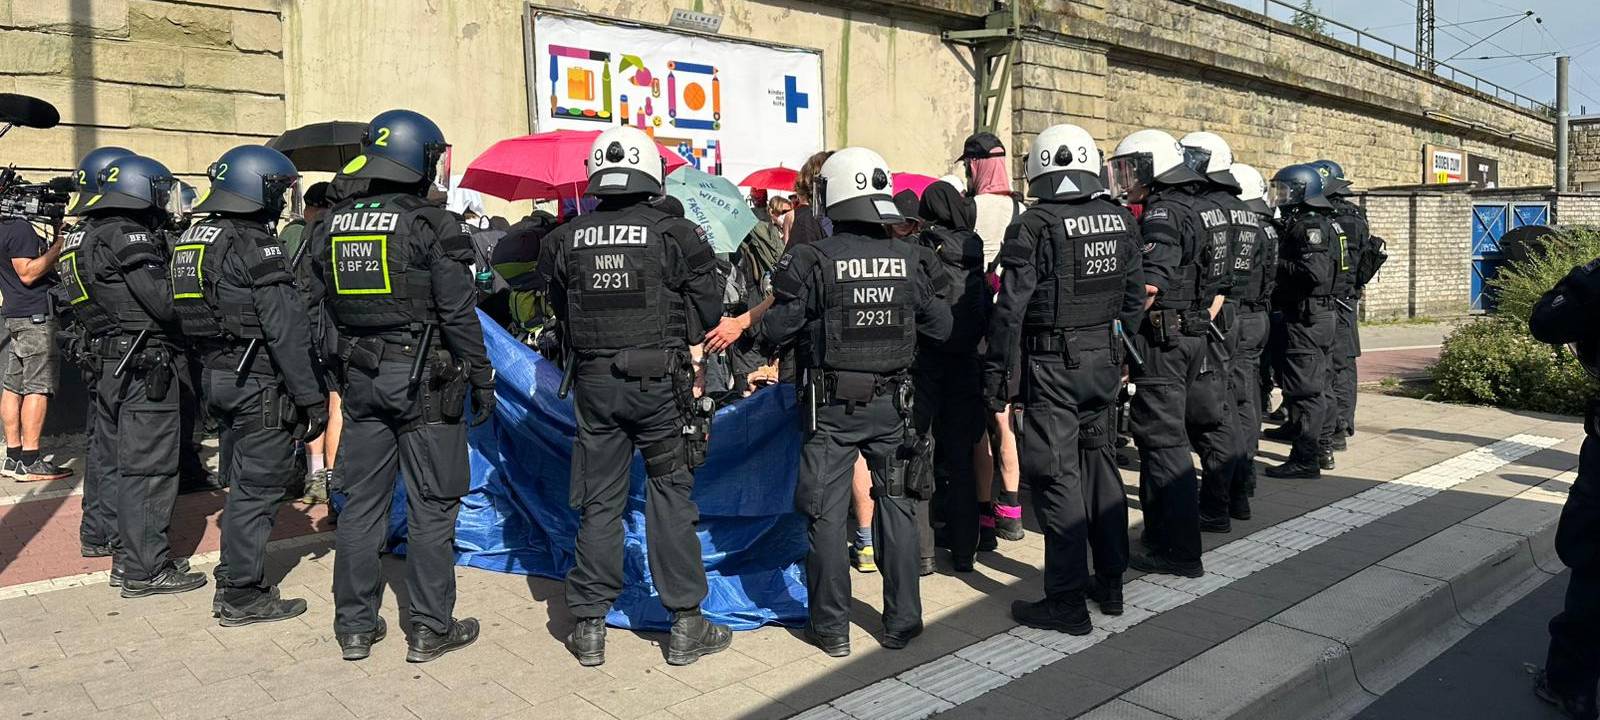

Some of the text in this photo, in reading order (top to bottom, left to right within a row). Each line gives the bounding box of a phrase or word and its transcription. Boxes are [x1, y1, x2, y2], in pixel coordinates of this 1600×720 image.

[375, 127, 390, 146] 2
[594, 147, 640, 167] 9 3
[1041, 147, 1088, 167] 9 3
[79, 170, 87, 185] 2
[107, 167, 120, 182] 2
[217, 163, 228, 180] 2
[855, 172, 867, 190] 9
[699, 191, 739, 219] WIEDER
[330, 212, 399, 233] POLIZEI
[1064, 214, 1126, 236] POLIZEI
[128, 233, 147, 243] BFE
[573, 225, 648, 248] POLIZEI
[1238, 230, 1256, 243] NRW
[176, 250, 195, 264] NRW
[264, 246, 281, 257] BFE
[342, 243, 372, 258] NRW
[1084, 240, 1117, 258] NRW
[340, 261, 379, 272] 3 BF 22
[595, 254, 625, 270] NRW
[836, 258, 907, 279] POLIZEI
[1086, 257, 1117, 275] 2933
[186, 266, 196, 277] 22
[592, 273, 630, 289] 2931
[853, 287, 894, 304] NRW
[856, 310, 892, 326] 2931
